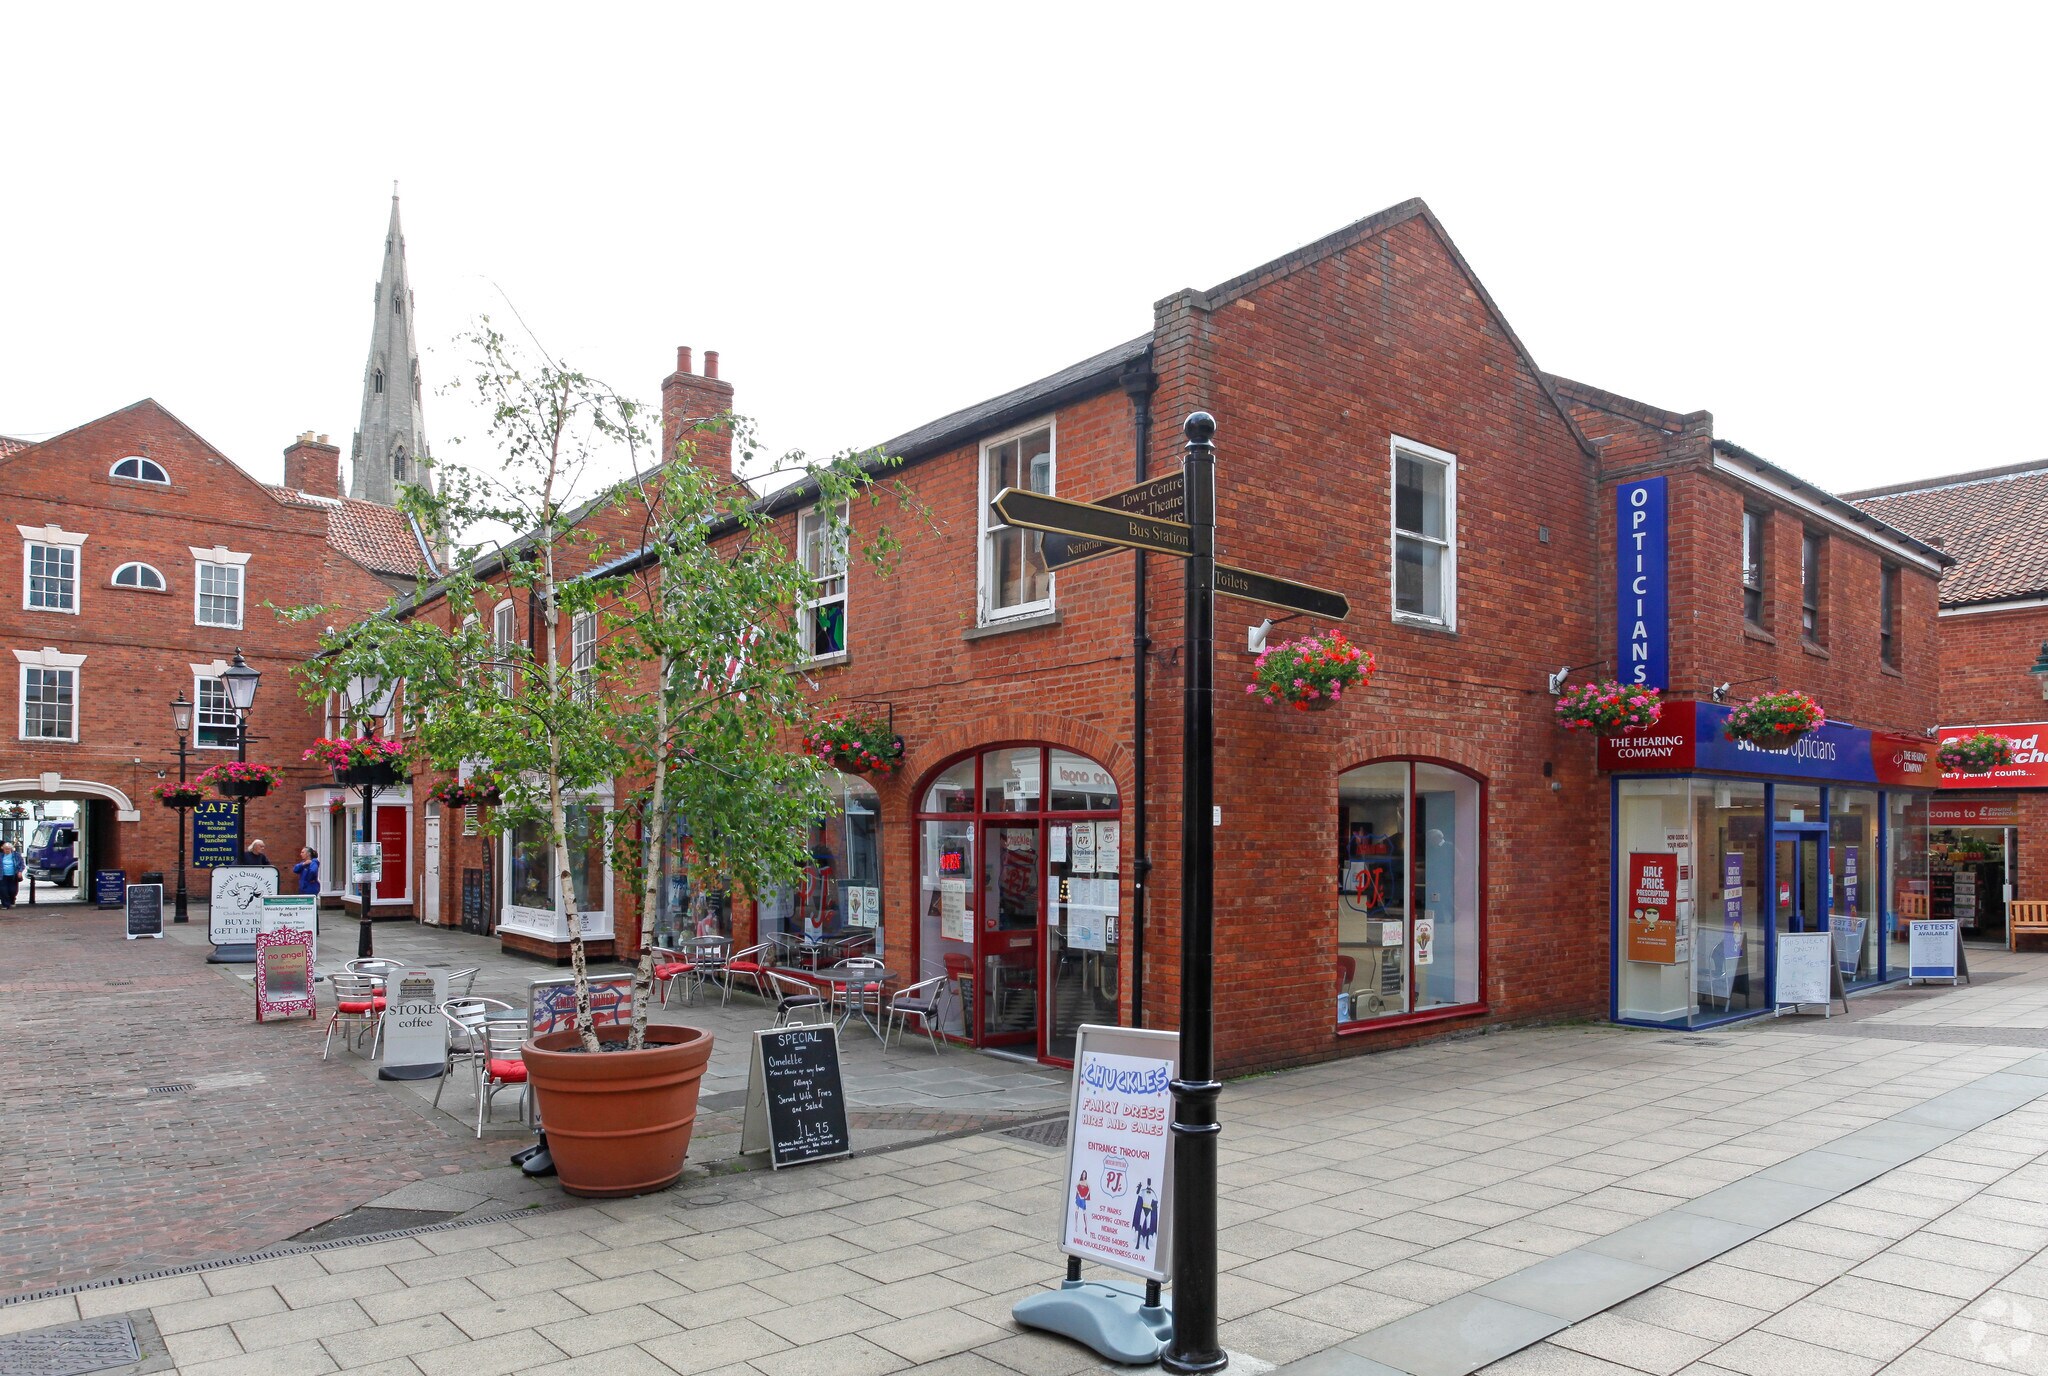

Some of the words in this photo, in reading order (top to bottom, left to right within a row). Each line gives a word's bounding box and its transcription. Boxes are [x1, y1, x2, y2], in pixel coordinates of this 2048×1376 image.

[1120, 489, 1147, 508] Town
[1150, 478, 1183, 497] Centre
[1147, 495, 1184, 516] Theatre
[1128, 521, 1149, 538] Bus
[1152, 525, 1189, 547] Station
[1215, 570, 1248, 591] Toilets
[1630, 488, 1648, 684] OPTICIANS
[1610, 738, 1632, 748] THE
[1633, 735, 1683, 747] HEARING
[1618, 747, 1673, 758] COMPANY
[1790, 734, 1836, 764] opticians
[1903, 750, 1912, 761] THE
[1903, 763, 1922, 773] COMPANY
[1941, 771, 1960, 780] very
[1964, 809, 1976, 818] to
[1643, 865, 1663, 878] HALF
[216, 873, 238, 900] Richard's
[239, 870, 265, 882] Quality
[1641, 877, 1665, 890] PRICE
[1636, 889, 1670, 898] PRESCRIPTION
[1637, 897, 1668, 905] SUNGLASSES
[281, 950, 304, 960] angel
[389, 1003, 442, 1016] STOKES
[398, 1016, 433, 1028] coffee
[778, 1030, 822, 1047] SPECIAL
[768, 1053, 803, 1068] Omelette
[815, 1064, 826, 1073] two
[1084, 1063, 1169, 1095] CHUCKLES
[777, 1092, 797, 1105] Served
[817, 1088, 833, 1098] Fries
[791, 1106, 802, 1114] and
[804, 1099, 824, 1111] Salad
[1082, 1097, 1118, 1114] FANCY
[1123, 1103, 1165, 1121] DRESS
[1082, 1114, 1104, 1127] HIRE
[1107, 1118, 1127, 1131] AND
[1131, 1120, 1164, 1137] SALES
[1088, 1141, 1117, 1154] ENTRANCE
[1119, 1146, 1150, 1160] THROUGH
[1106, 1206, 1122, 1215] MARKS
[1091, 1213, 1113, 1224] SHOPPING
[1113, 1219, 1130, 1228] CENTRE
[1101, 1225, 1118, 1235] NEWARK
